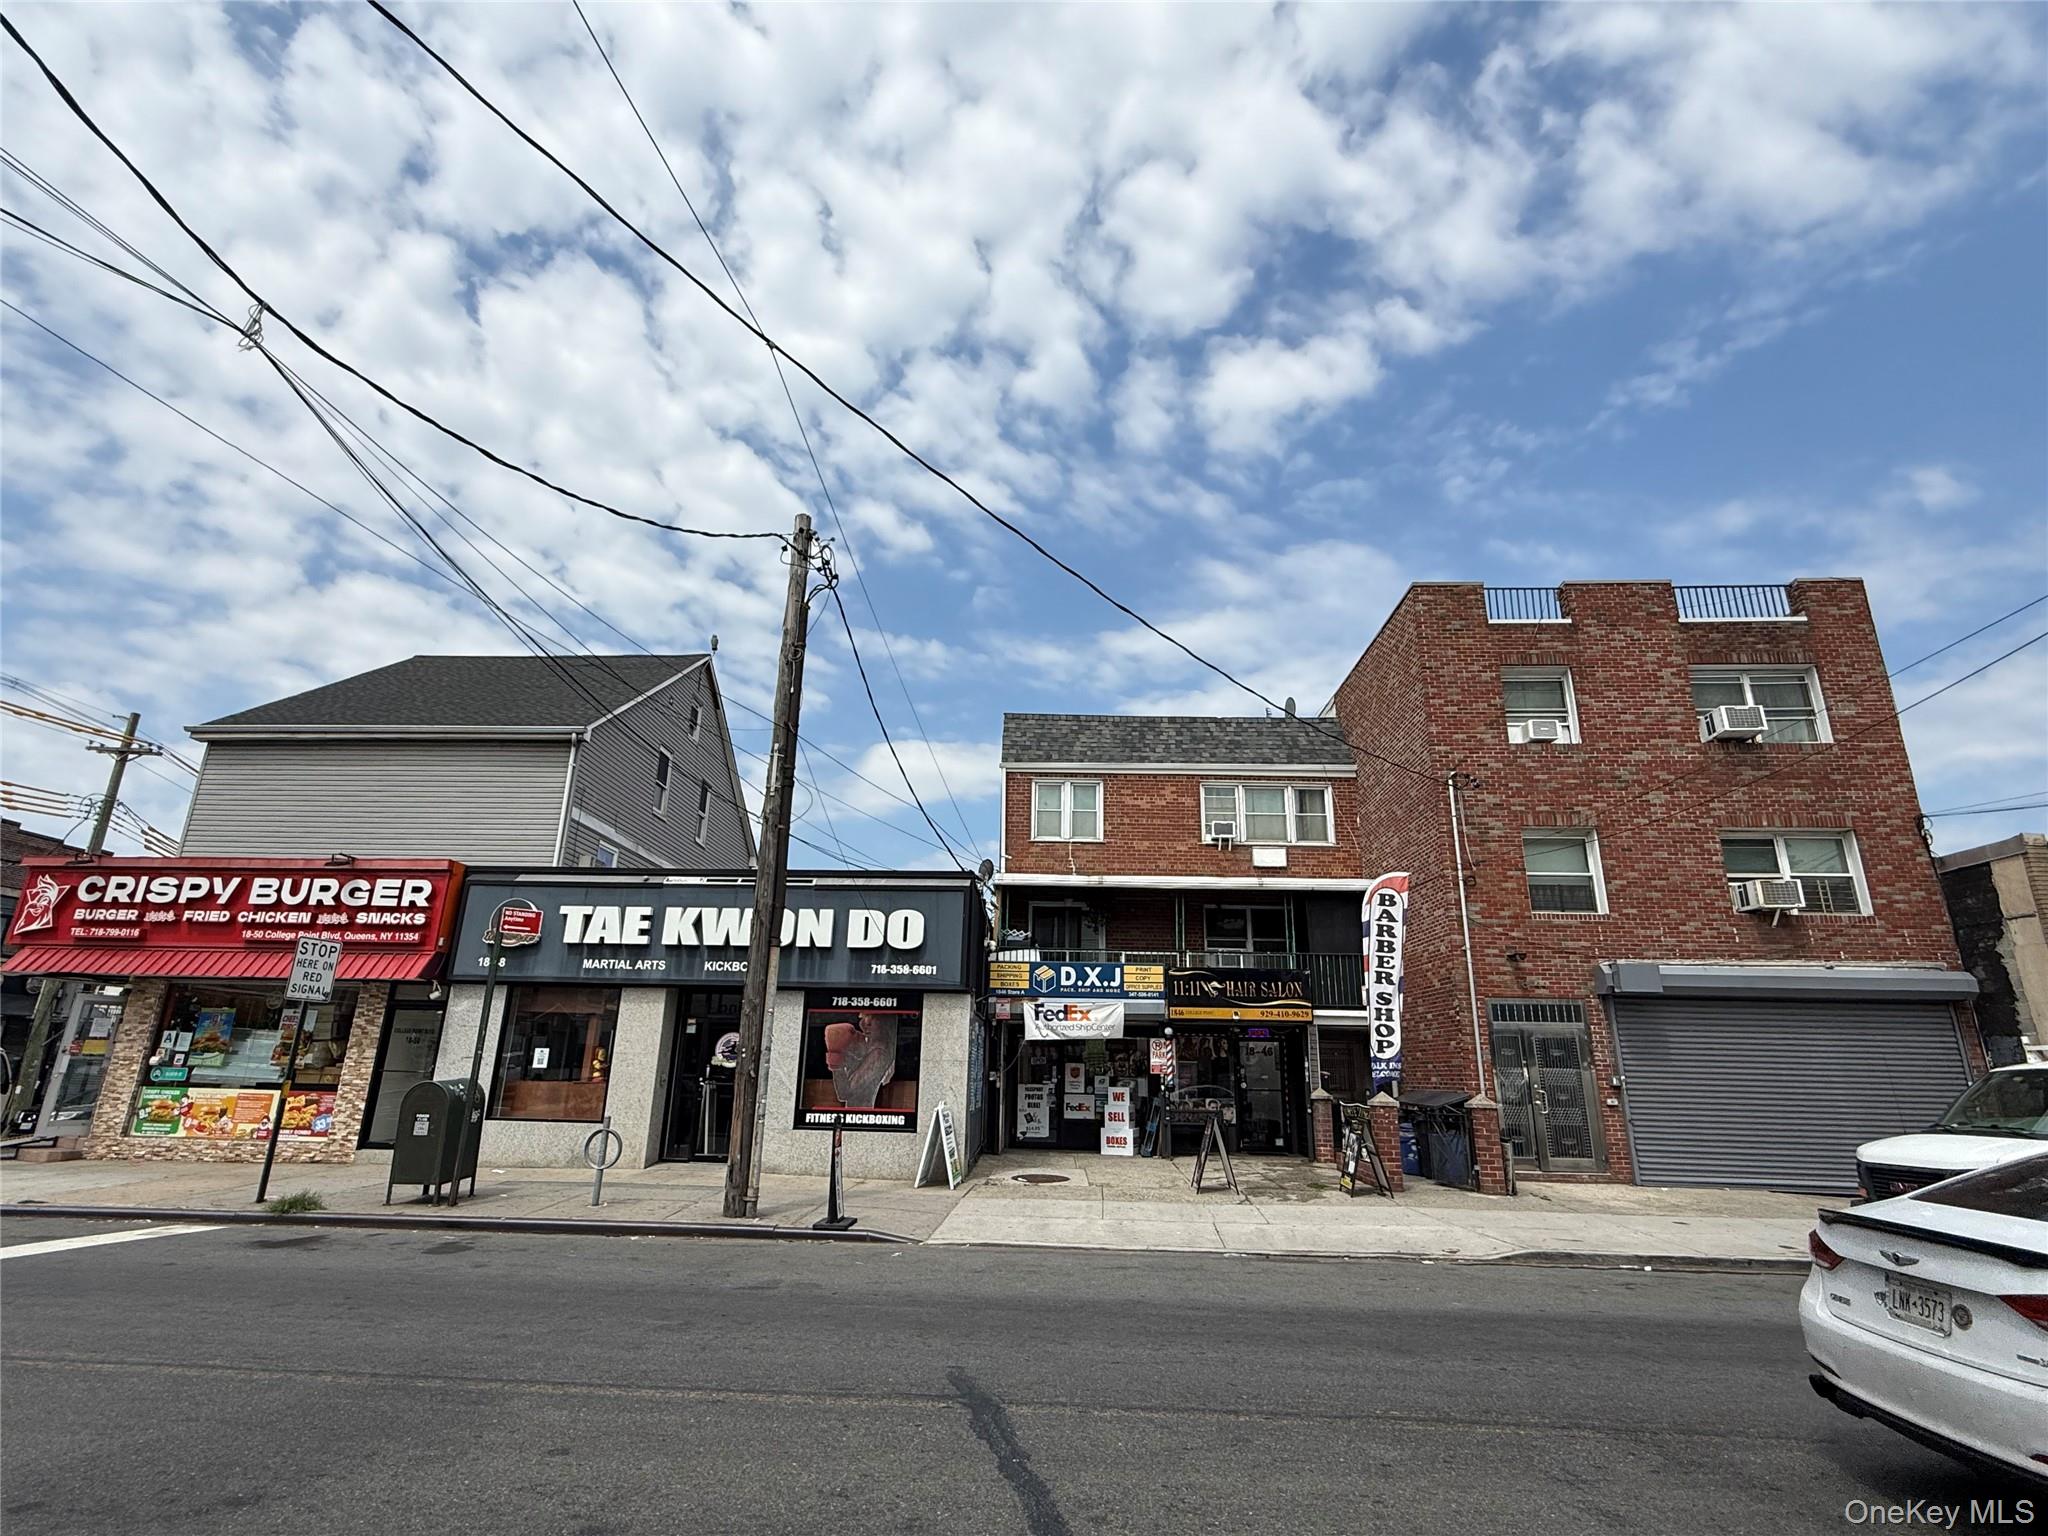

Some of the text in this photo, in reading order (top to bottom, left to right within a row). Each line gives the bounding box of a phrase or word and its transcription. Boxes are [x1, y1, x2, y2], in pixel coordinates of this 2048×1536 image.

[77, 875, 433, 907] CRISPY BURGER
[73, 908, 426, 925] BURGER FRIED CHICKEN SNACKS
[70, 927, 140, 937] TEL: 718-799-0116
[559, 905, 653, 945] TAE
[846, 908, 926, 950] DO
[241, 930, 419, 943] 18-50 College Point Blvd, Queens, NY 11354
[1374, 892, 1399, 985] BARBER
[299, 942, 339, 959] STOP
[296, 959, 334, 971] HERE ON
[582, 958, 633, 970] MARTIAL
[635, 959, 666, 971] ARTS
[870, 964, 938, 976] 718-358-6601
[302, 972, 322, 983] RED
[1060, 966, 1121, 987] D.X.J
[290, 983, 326, 996] SIGNAL
[1226, 980, 1257, 998] HAIR
[1261, 981, 1303, 998] SALON
[831, 996, 898, 1007] 718-358-6601
[1034, 1003, 1092, 1022] FedEx
[1374, 991, 1396, 1054] SHOP
[163, 1032, 173, 1044] A
[1112, 1091, 1126, 1102] WE
[1065, 1102, 1091, 1112] FedEx
[845, 1113, 905, 1125] KICKBOXING
[1107, 1111, 1126, 1122] SELL
[1105, 1135, 1128, 1146] BOXES
